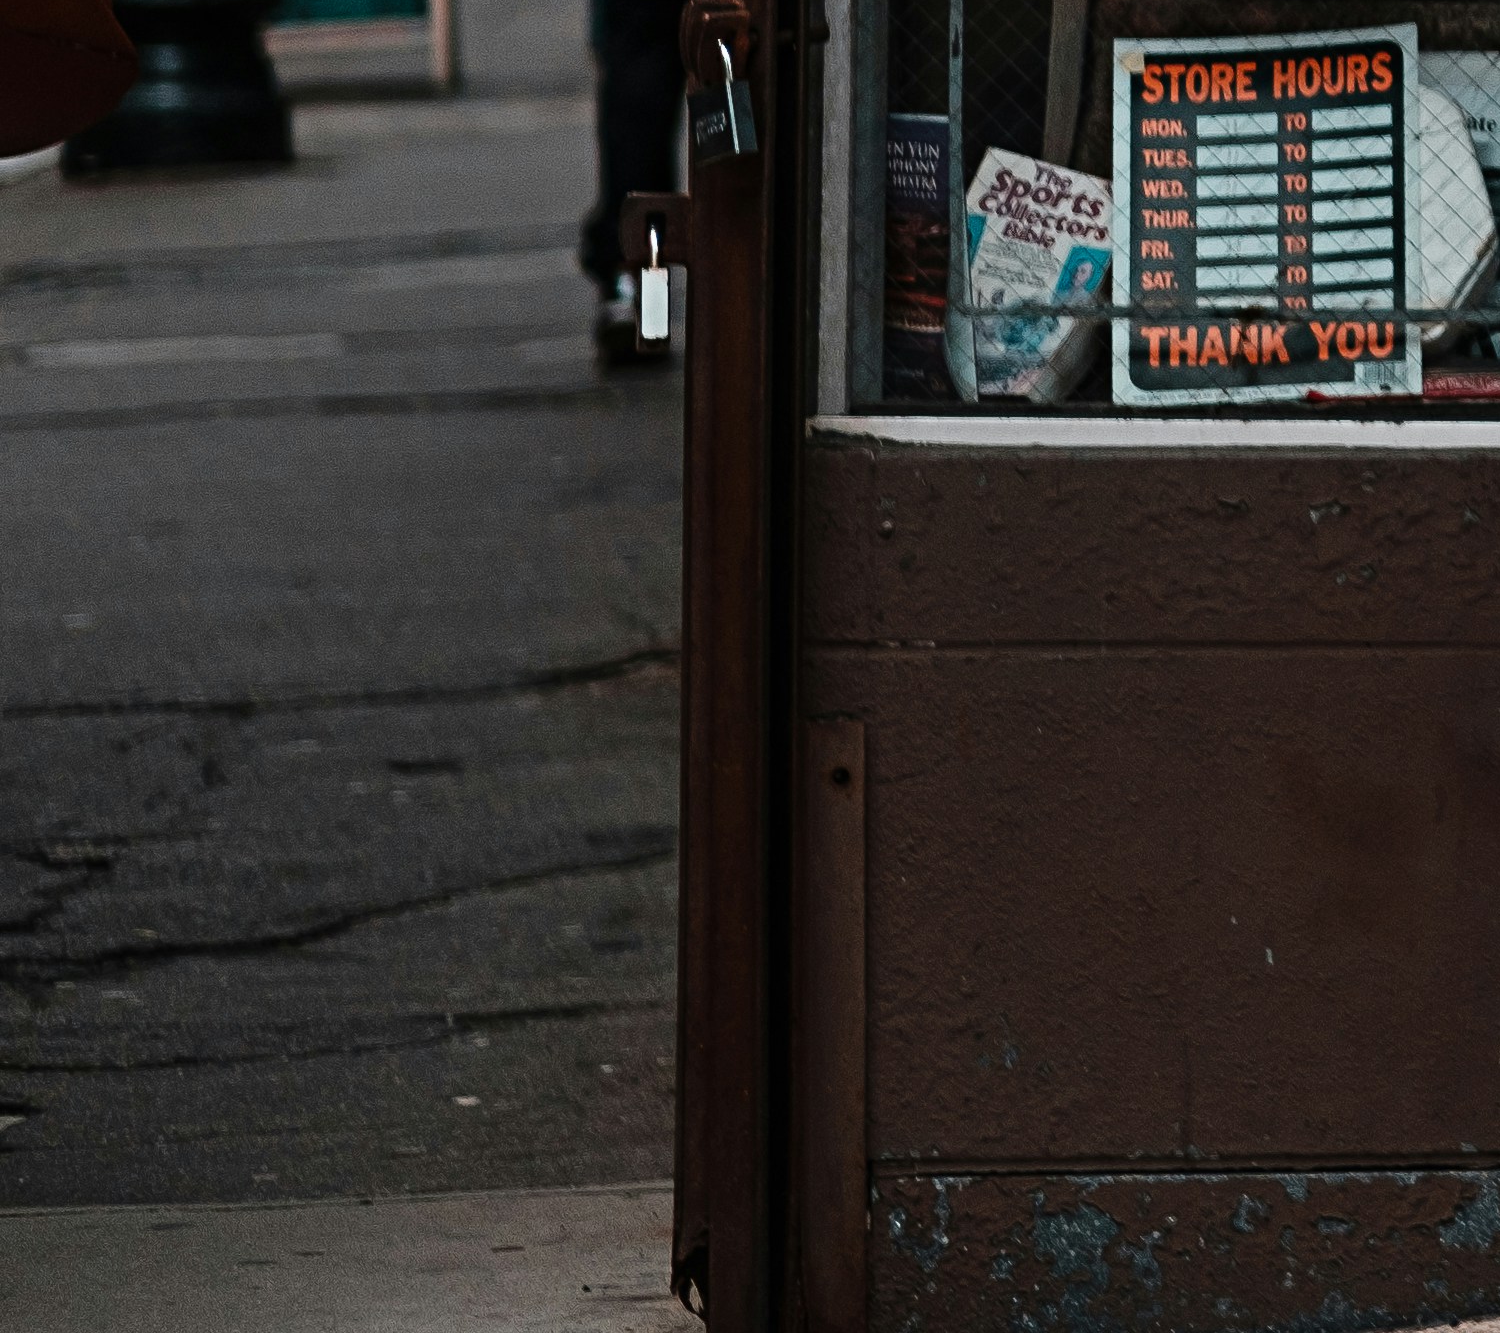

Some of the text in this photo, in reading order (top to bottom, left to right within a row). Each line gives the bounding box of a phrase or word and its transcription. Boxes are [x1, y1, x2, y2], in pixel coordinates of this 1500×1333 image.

[1141, 50, 1395, 105] STORE HOURS
[1140, 112, 1308, 138] MON. TO
[1141, 142, 1308, 169] TUES. TO
[1036, 165, 1073, 191] The
[1141, 173, 1308, 200] WED. TO
[990, 169, 1104, 216] Sports
[979, 195, 1108, 241] Collectors
[1140, 204, 1308, 230] THUR. TO
[1140, 235, 1308, 261] FRI. TO
[1140, 265, 1308, 292] SAT. TO
[1140, 320, 1396, 368] THANK YOU
